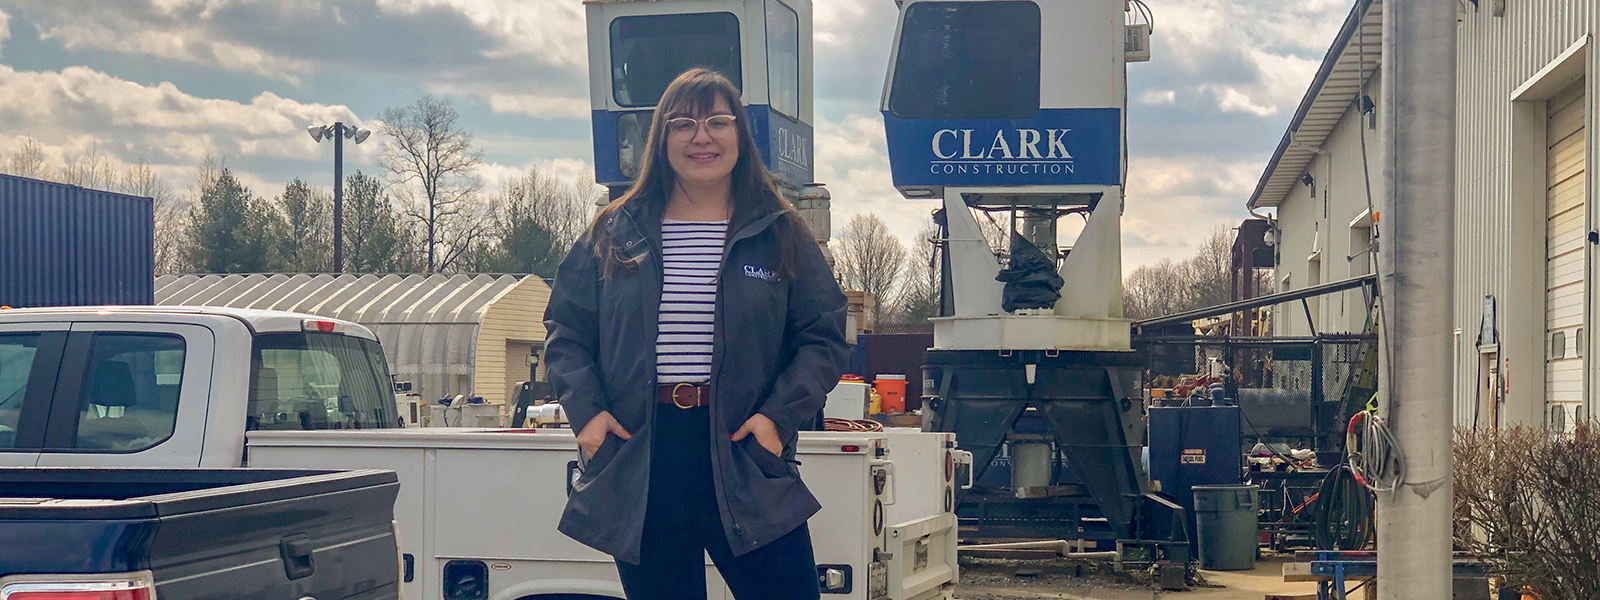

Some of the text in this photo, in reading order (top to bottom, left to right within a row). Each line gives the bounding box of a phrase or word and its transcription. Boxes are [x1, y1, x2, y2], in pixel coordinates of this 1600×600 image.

[779, 127, 807, 167] CLARK
[931, 128, 1073, 159] CLARK
[930, 164, 1074, 174] CONSTRUCTION
